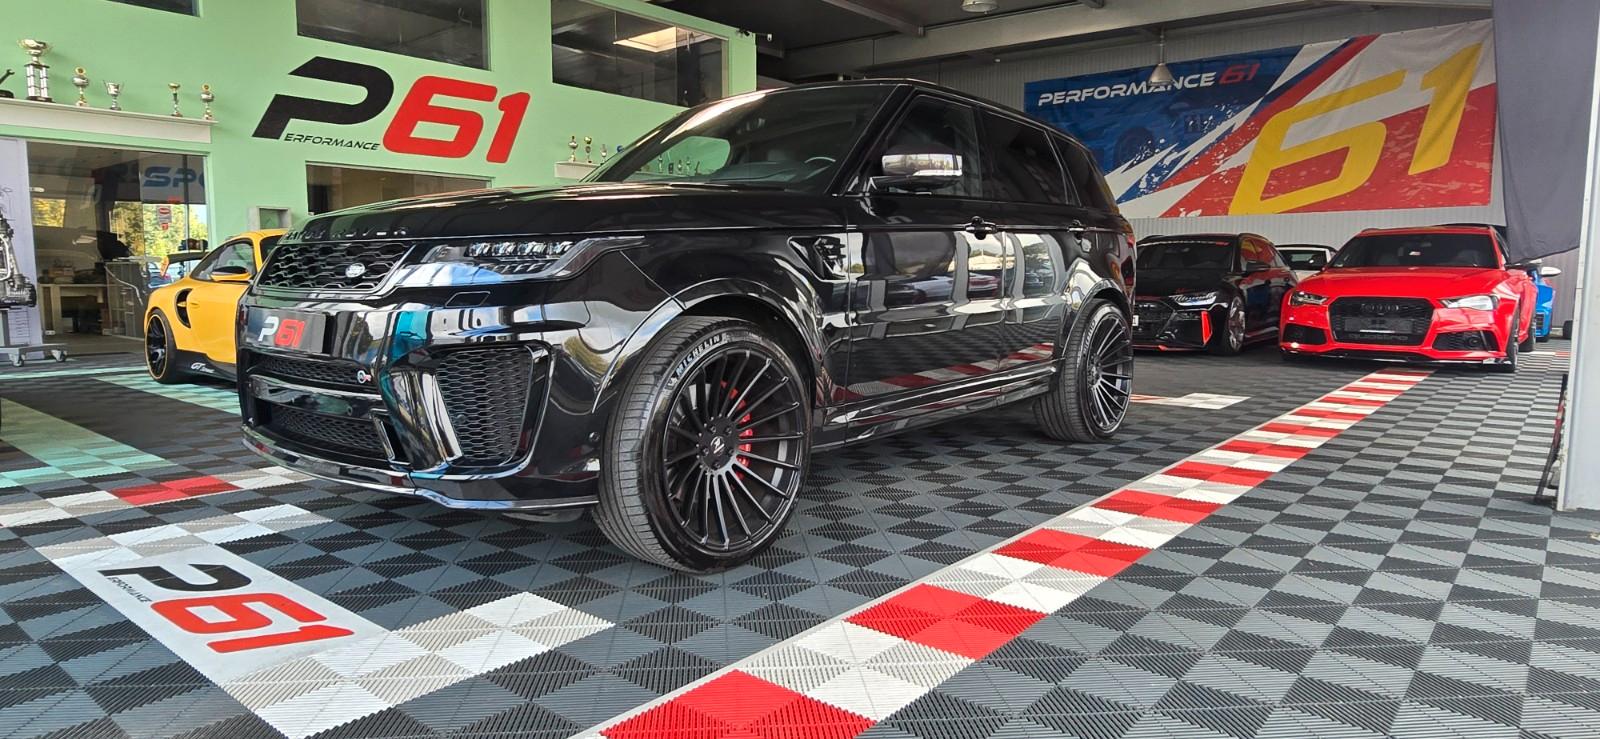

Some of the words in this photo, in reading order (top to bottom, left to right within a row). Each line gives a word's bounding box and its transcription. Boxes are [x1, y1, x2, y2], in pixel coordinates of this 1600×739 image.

[1038, 71, 1217, 107] PERFORMANCE
[1218, 63, 1262, 85] 61
[284, 133, 381, 151] ERFORMANCE
[1228, 42, 1483, 215] 61
[257, 315, 308, 348] P61
[674, 335, 721, 378] MICHELIN
